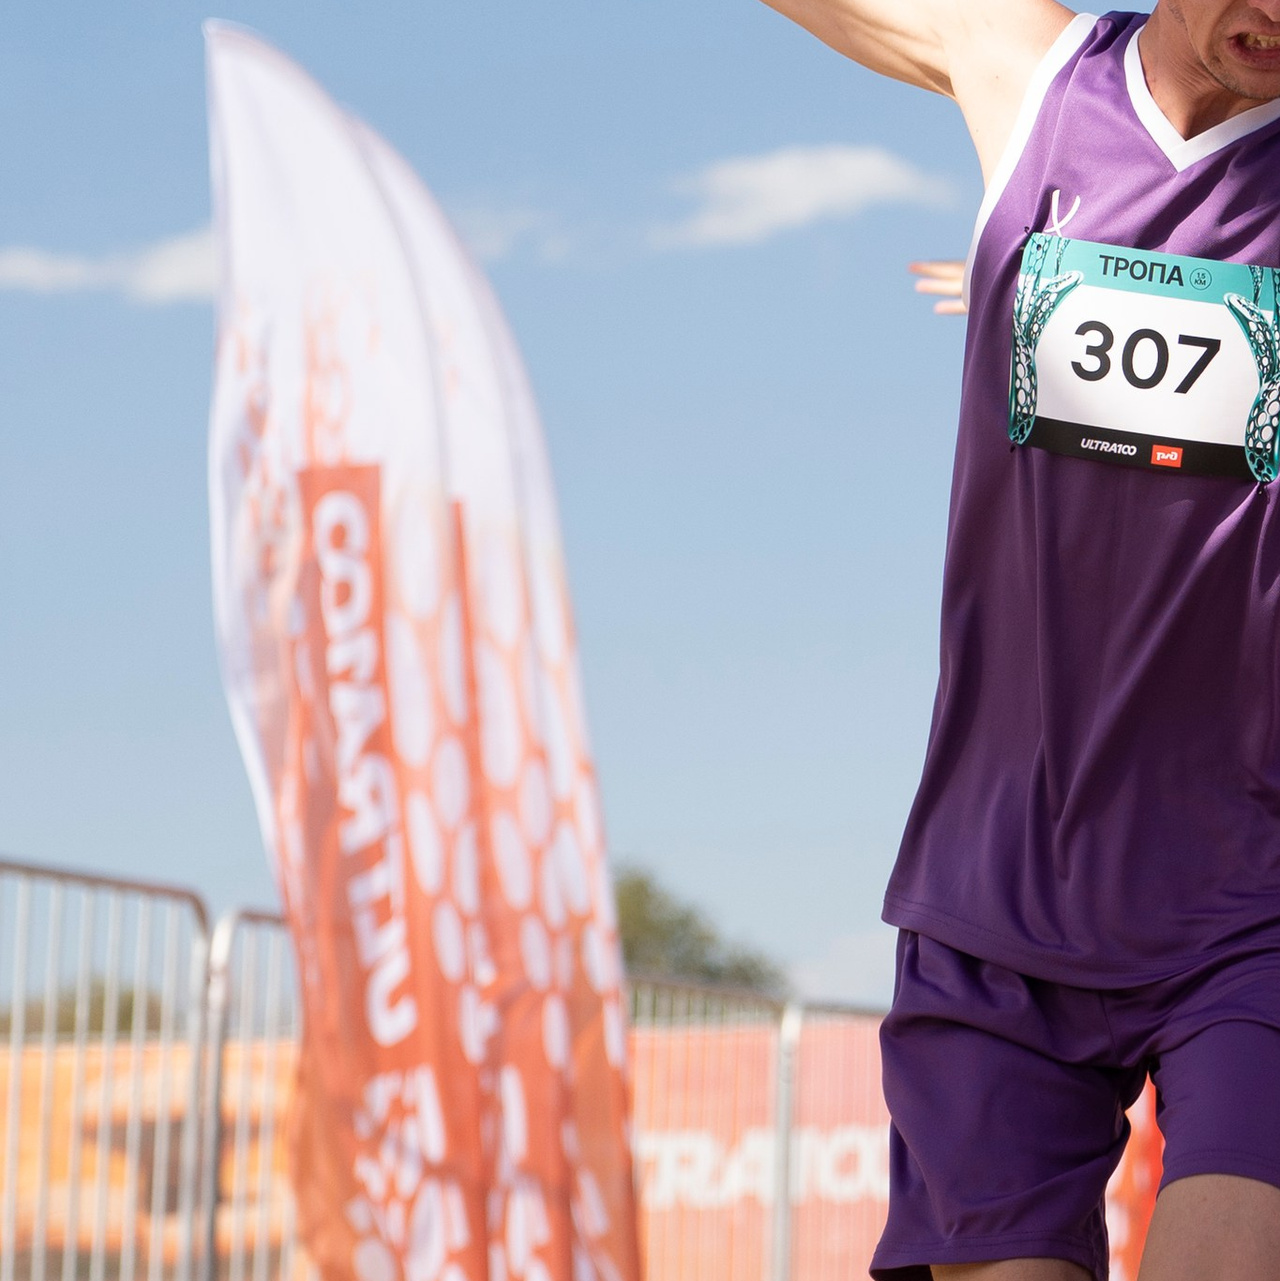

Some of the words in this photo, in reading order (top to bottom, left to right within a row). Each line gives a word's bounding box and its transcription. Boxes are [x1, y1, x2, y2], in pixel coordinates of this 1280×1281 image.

[1099, 254, 1184, 287] ТРОПА
[1071, 320, 1221, 394] 307
[1081, 438, 1137, 456] ULTRA100
